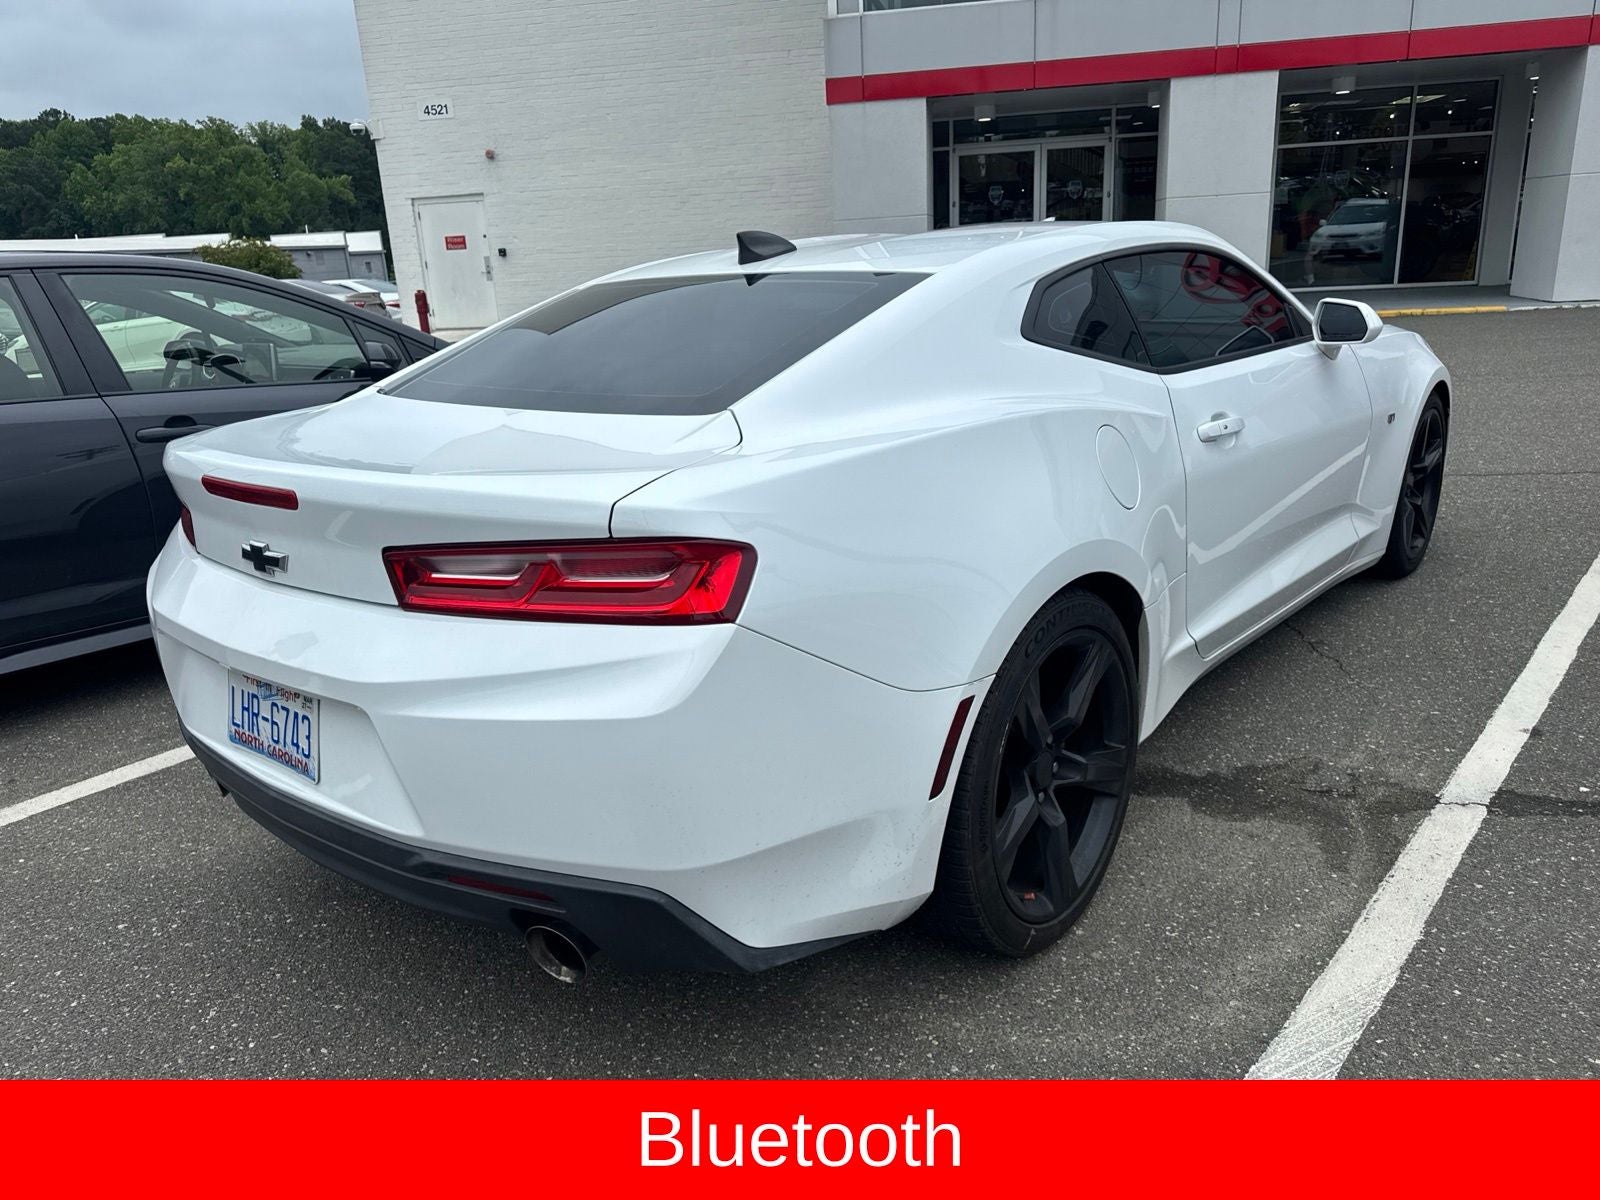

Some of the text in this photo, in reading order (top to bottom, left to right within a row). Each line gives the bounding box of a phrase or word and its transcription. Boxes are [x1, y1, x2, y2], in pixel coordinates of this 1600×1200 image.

[423, 103, 448, 116] 4521
[231, 685, 311, 759] LHR-6743
[234, 728, 310, 776] NORTH CAROLINA
